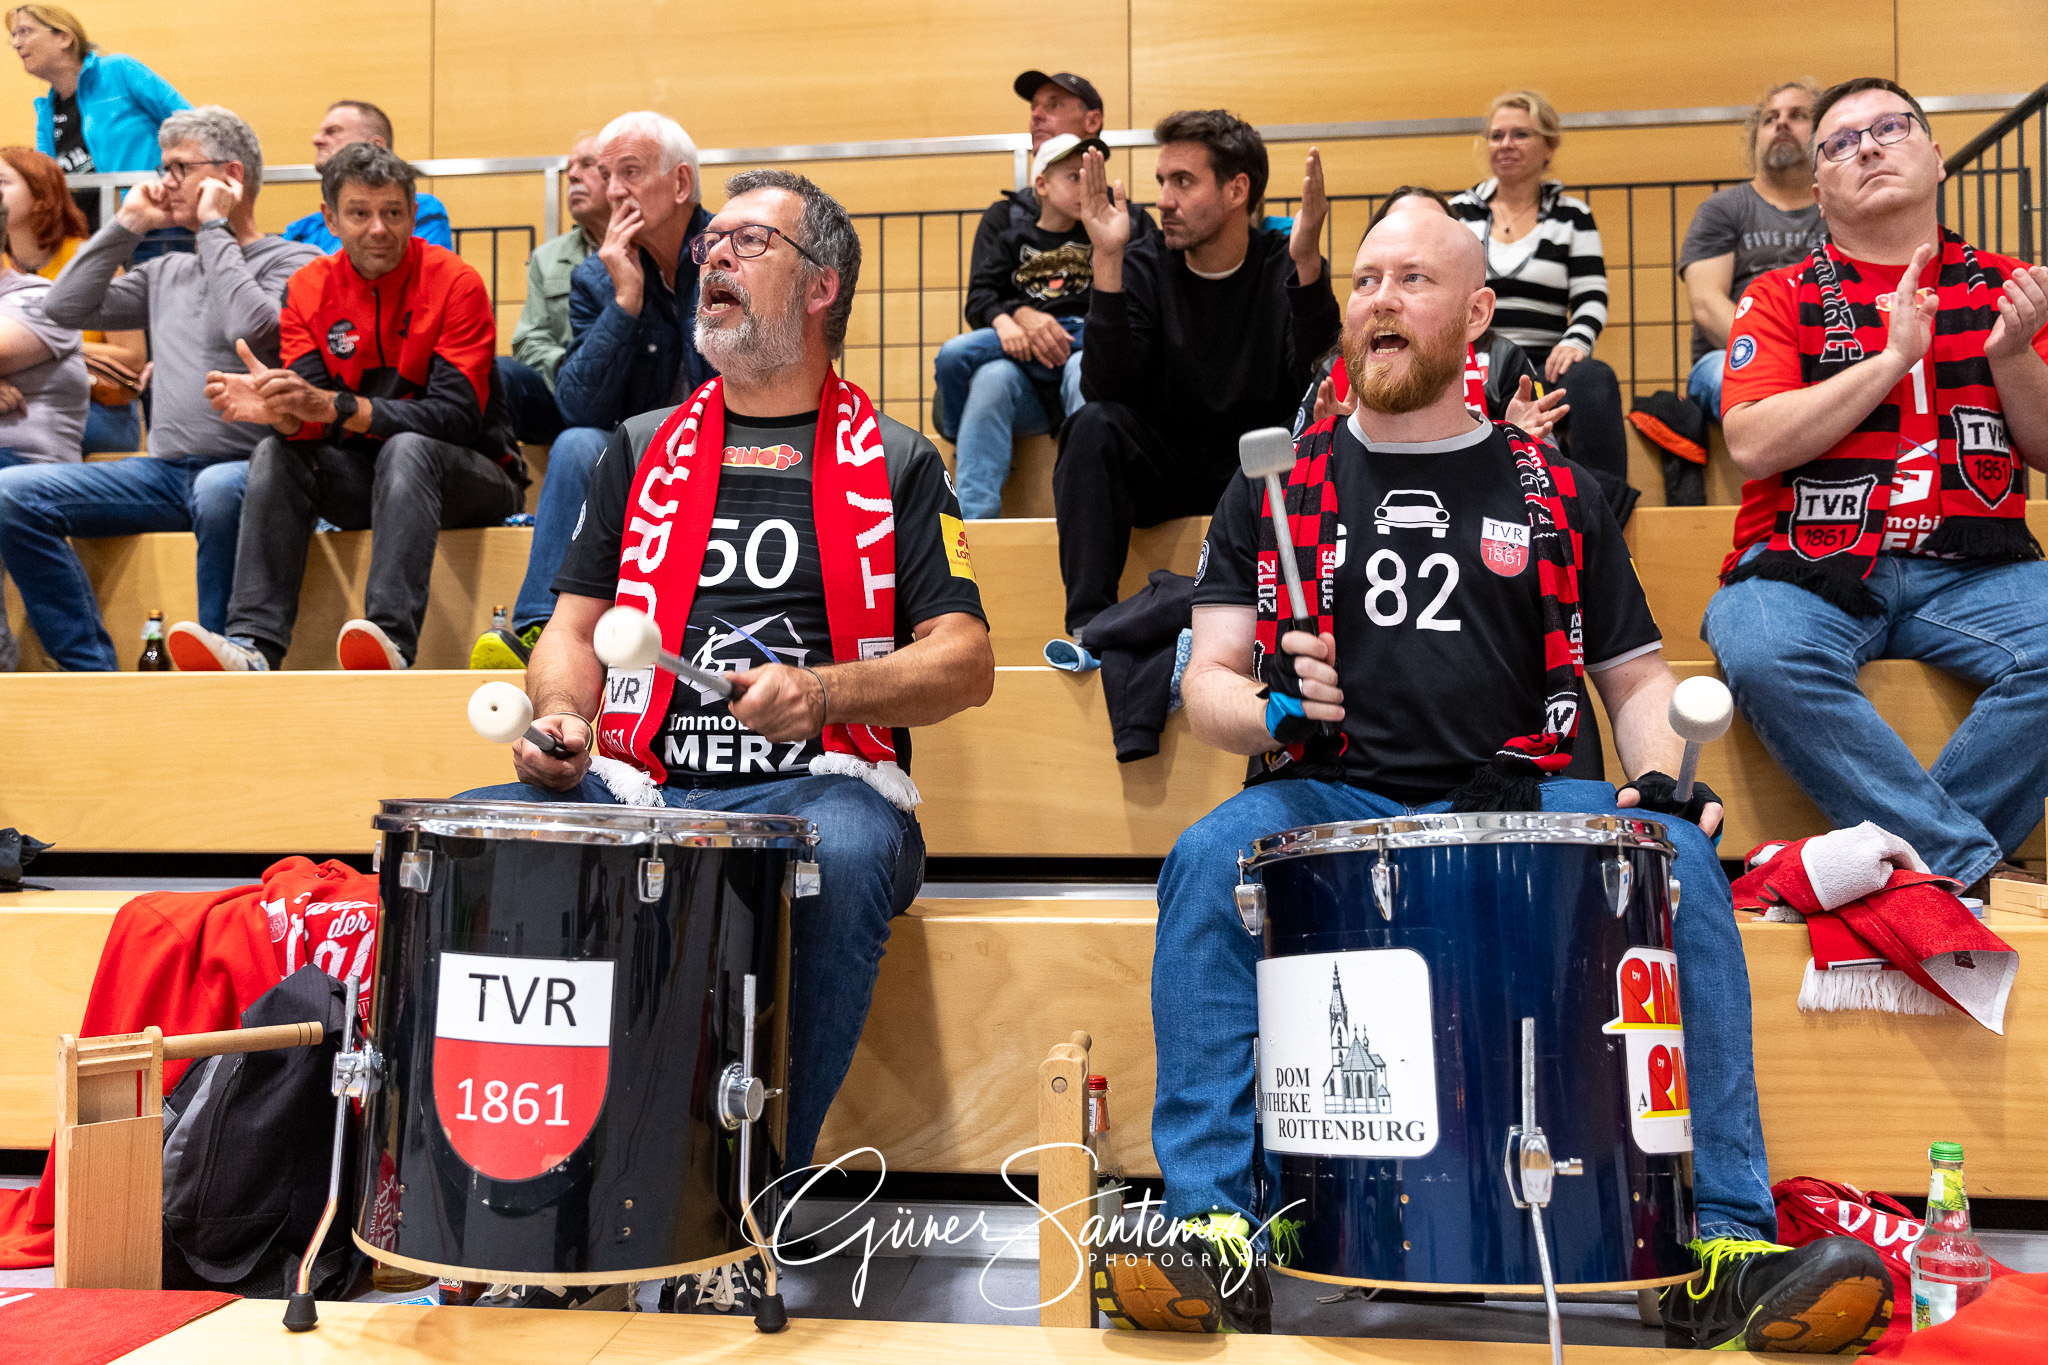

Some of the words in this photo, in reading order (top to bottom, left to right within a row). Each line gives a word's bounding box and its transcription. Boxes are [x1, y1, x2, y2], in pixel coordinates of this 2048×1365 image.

[1974, 458, 2008, 482] 1861
[1805, 494, 1859, 516] TVR
[1489, 522, 1524, 541] TVR
[1804, 528, 1847, 547] 1861
[698, 518, 799, 589] 50
[1486, 547, 1522, 567] 1861
[1257, 559, 1277, 613] 2012
[1364, 548, 1461, 631] 82
[606, 677, 641, 705] VR
[664, 734, 810, 773] MERZ
[327, 909, 372, 939] der
[1631, 969, 1641, 981] by
[468, 972, 577, 1027] TVR
[1621, 957, 1681, 1025] RIN
[1276, 1067, 1310, 1088] DOM
[455, 1077, 570, 1126] 1861
[1262, 1092, 1311, 1113] OTHEKE
[1278, 1118, 1425, 1142] ROTTENBURG
